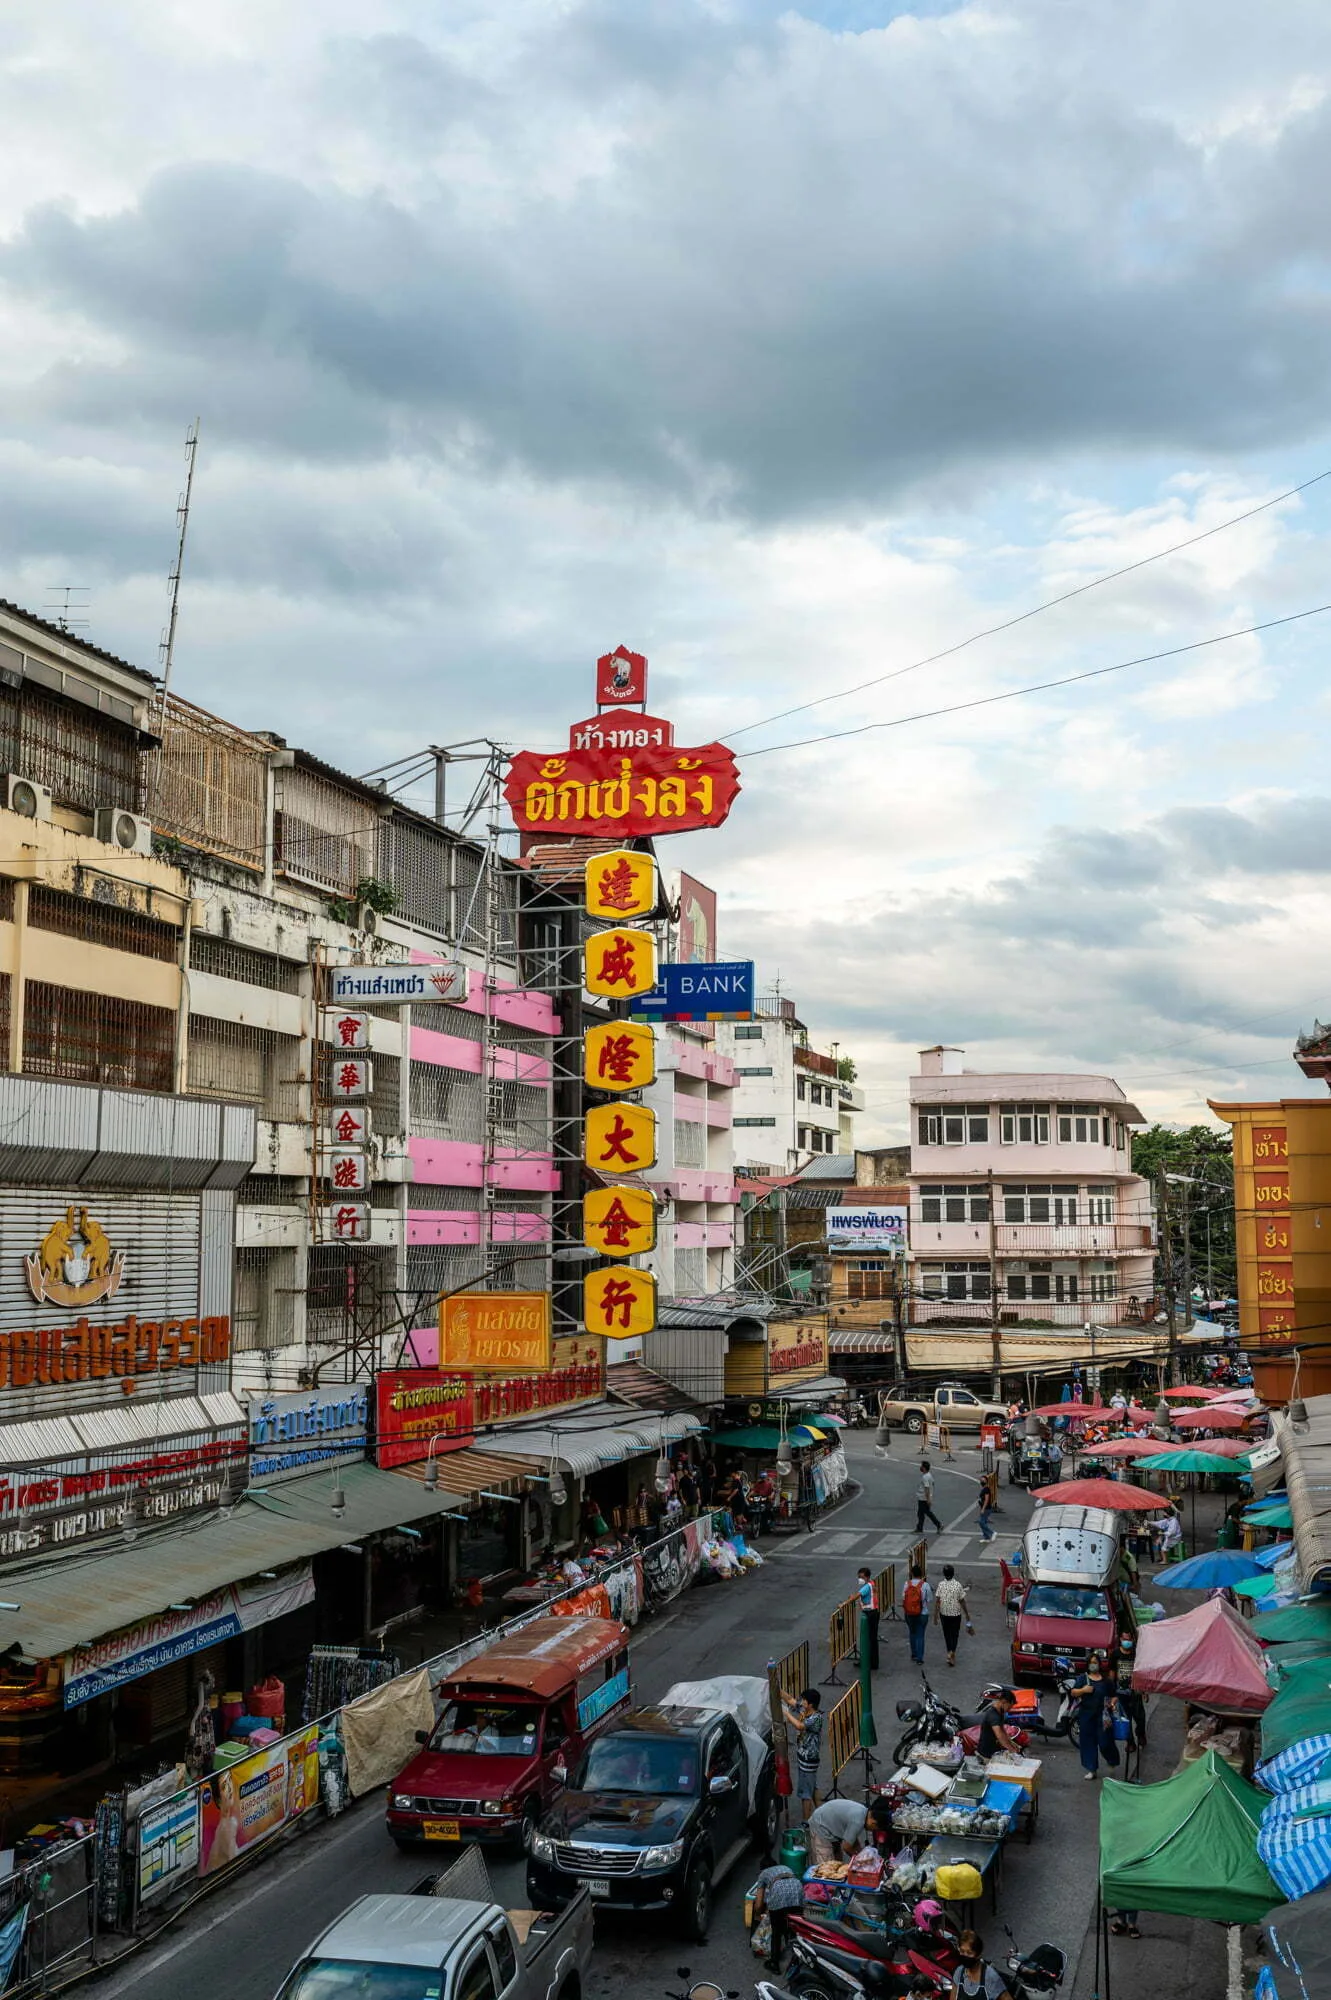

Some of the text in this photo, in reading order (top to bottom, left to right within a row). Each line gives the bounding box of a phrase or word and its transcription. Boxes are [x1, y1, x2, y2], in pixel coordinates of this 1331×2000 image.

[574, 723, 663, 750] ห้างทอง
[681, 975, 747, 995] BANK
[477, 1306, 541, 1330] แสงชัย
[475, 1339, 541, 1358] เยาวราช
